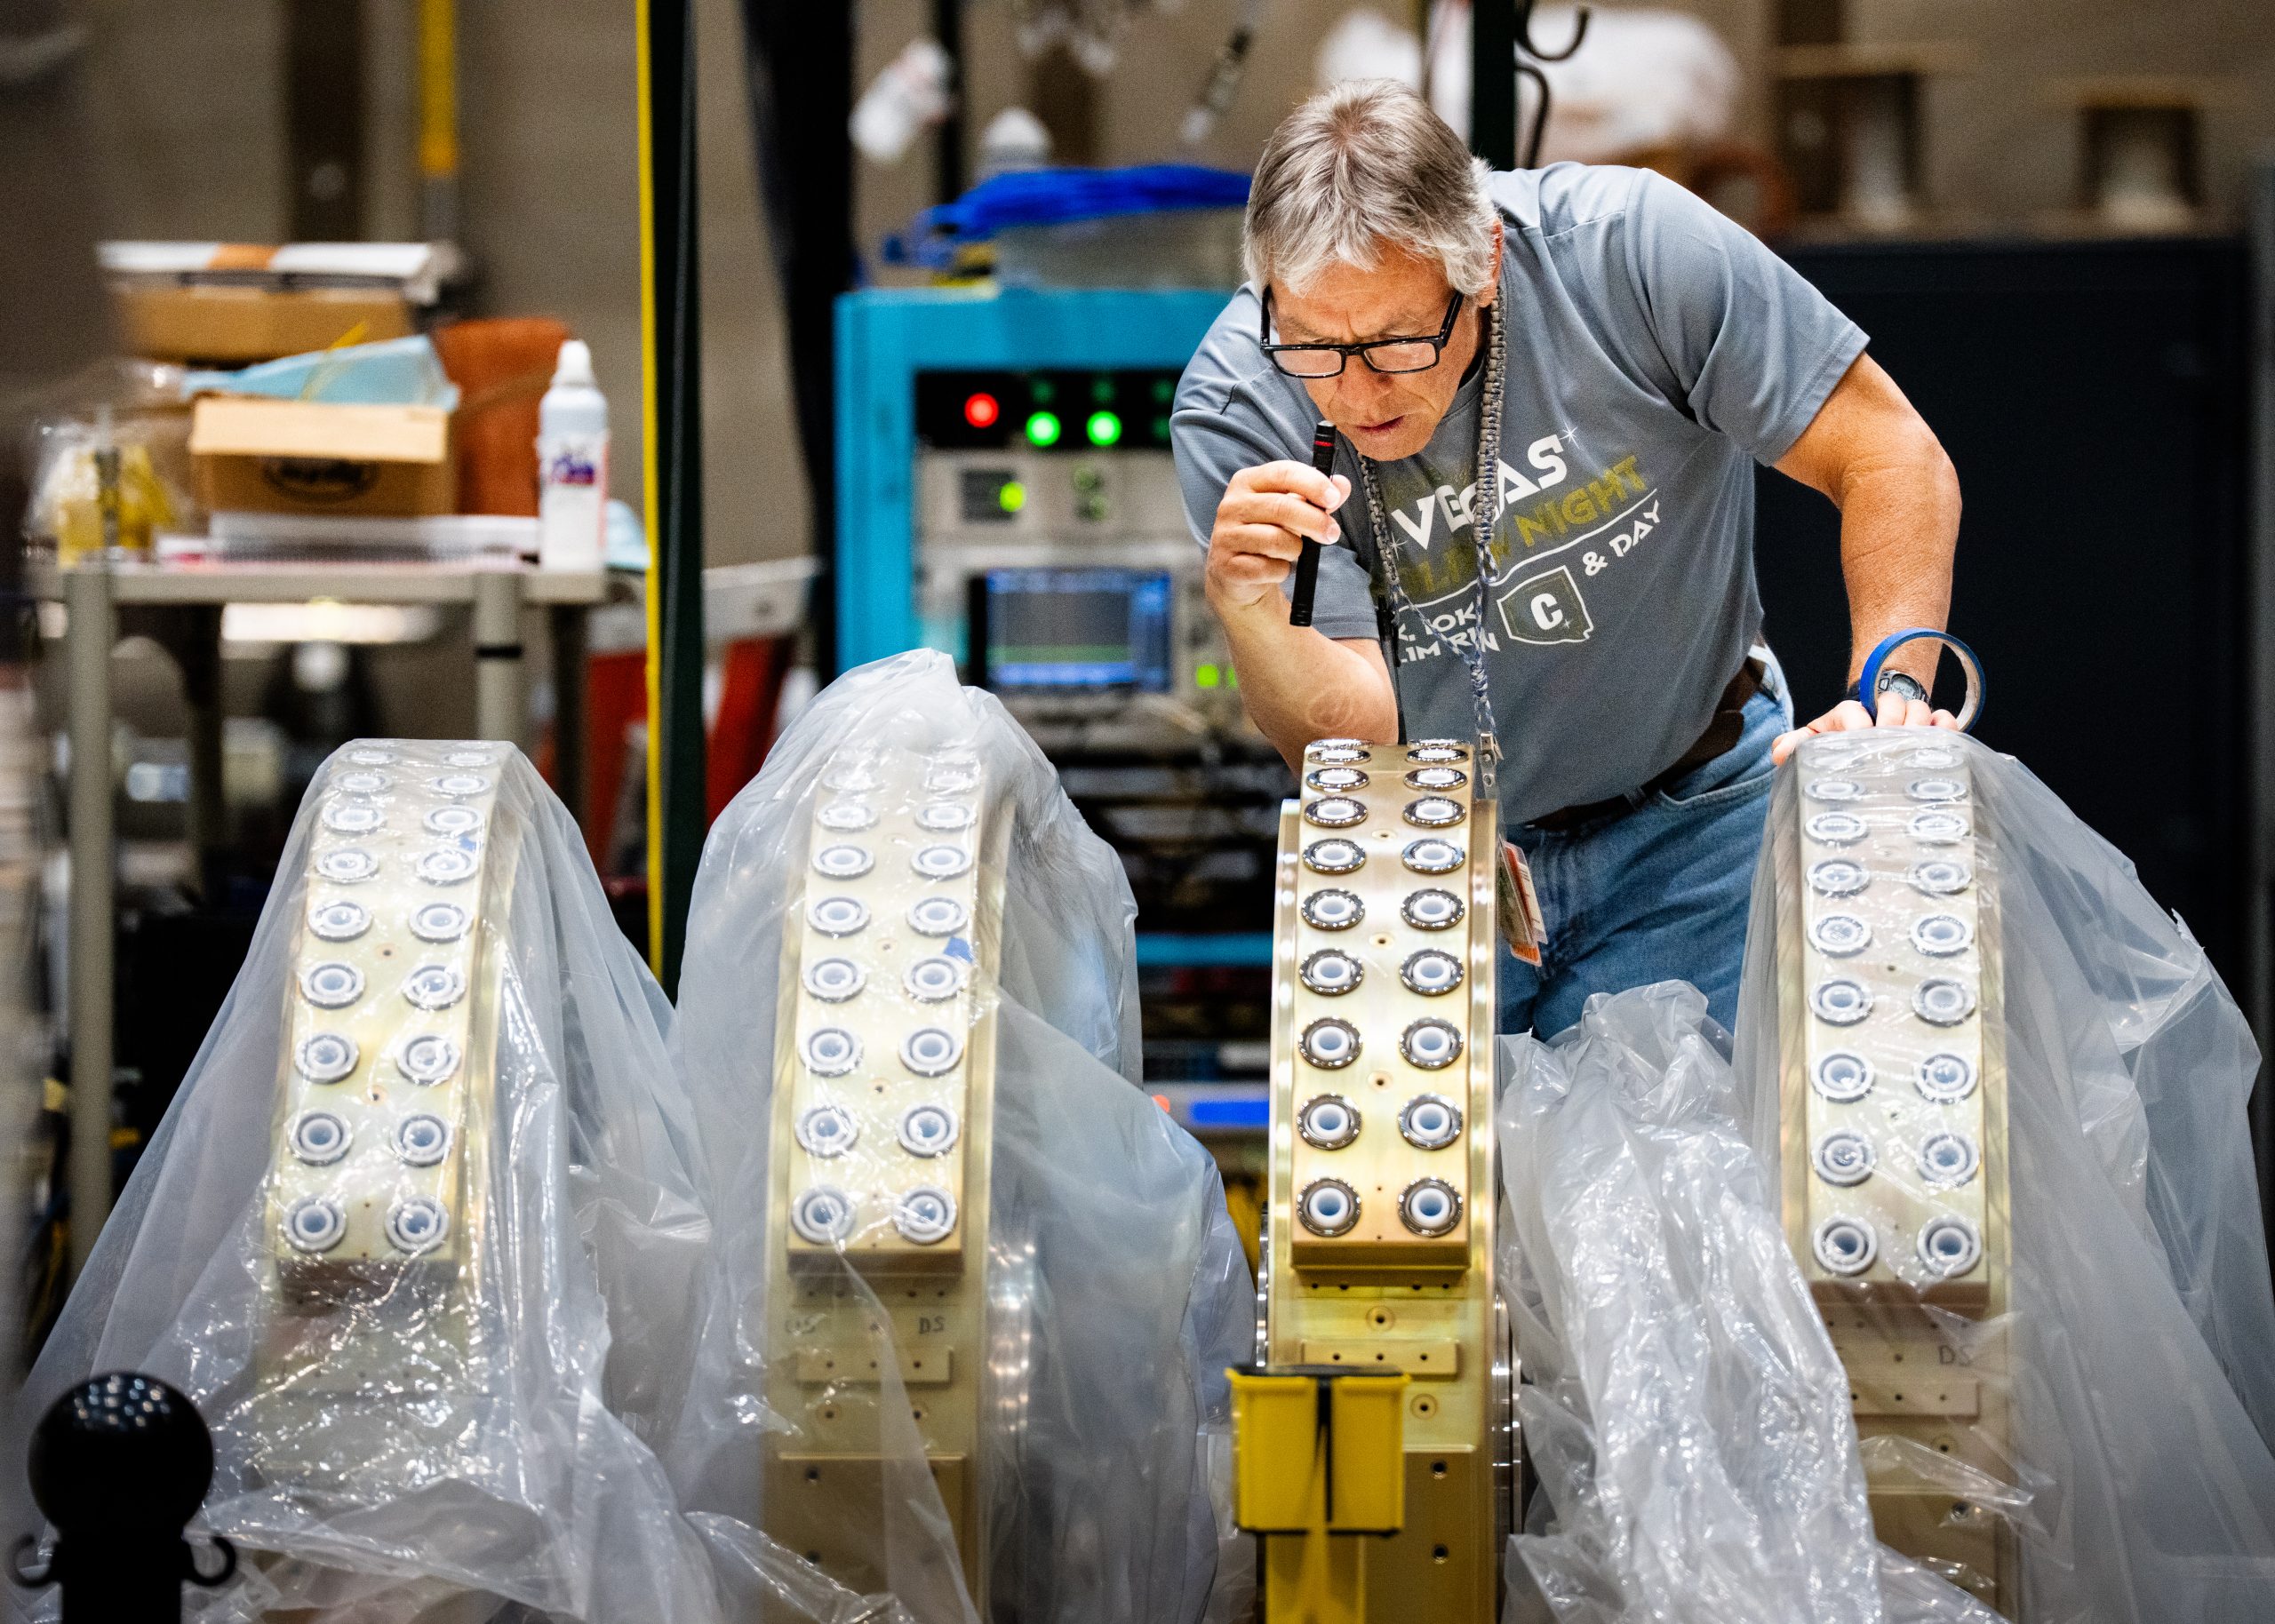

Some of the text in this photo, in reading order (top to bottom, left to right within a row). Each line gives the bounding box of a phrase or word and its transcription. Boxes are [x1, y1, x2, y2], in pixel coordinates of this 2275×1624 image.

[1513, 454, 1648, 548] NIGHT
[1582, 499, 1660, 576] & DAY
[1530, 593, 1563, 630] C
